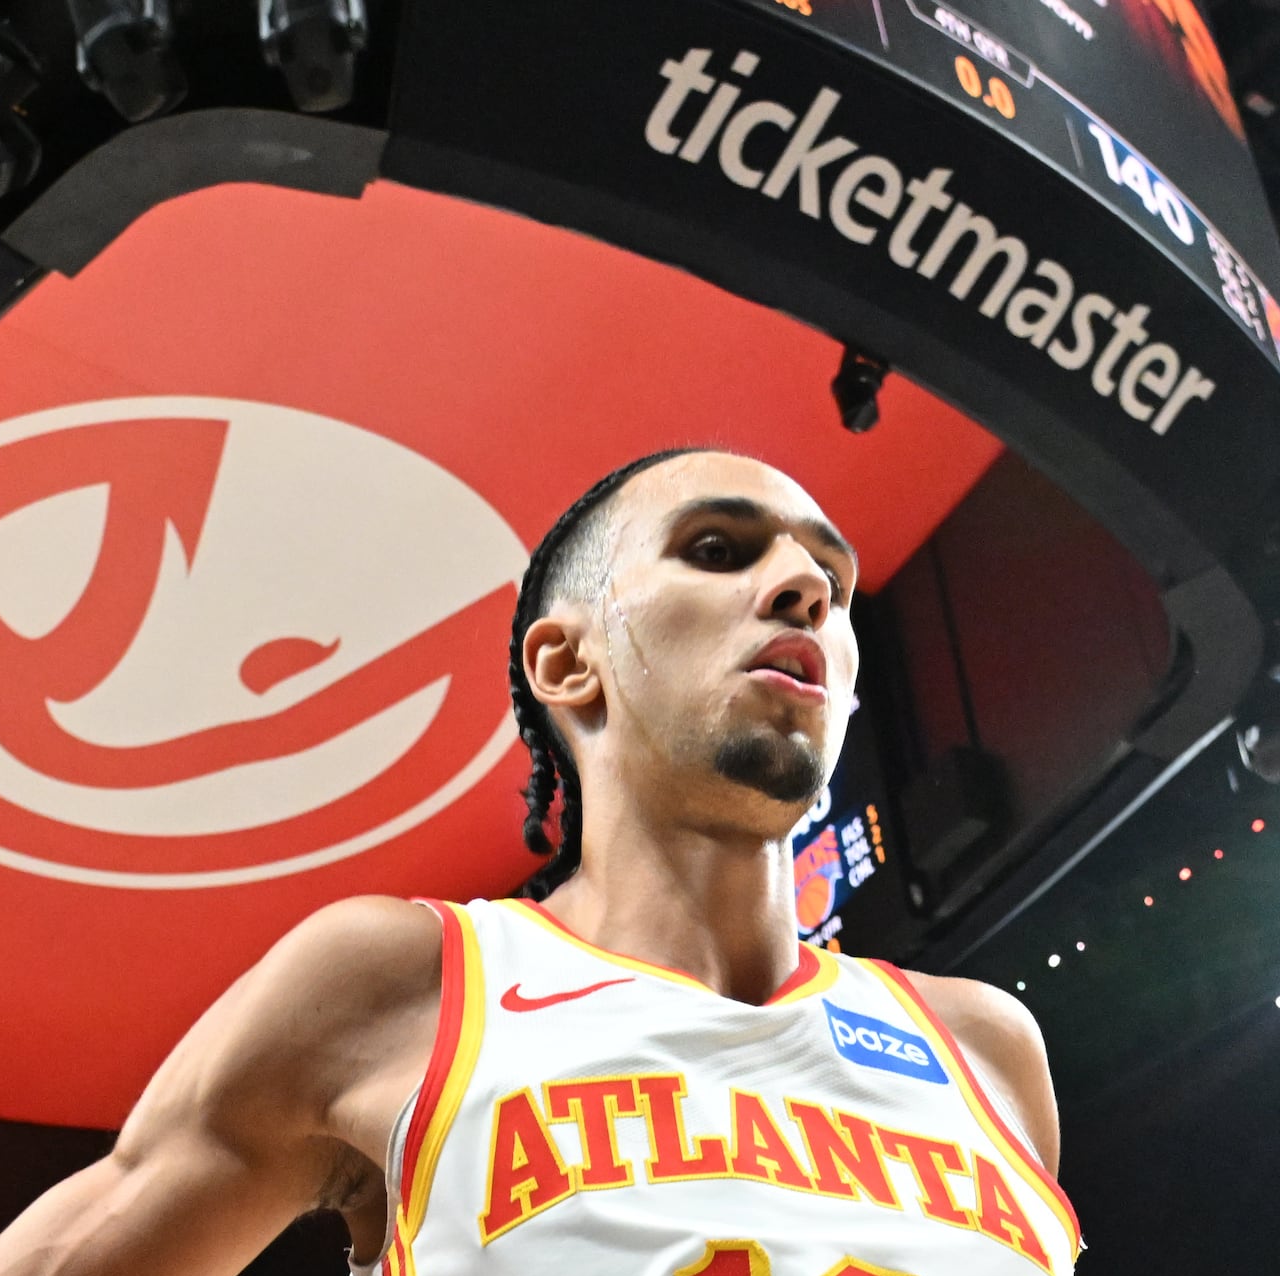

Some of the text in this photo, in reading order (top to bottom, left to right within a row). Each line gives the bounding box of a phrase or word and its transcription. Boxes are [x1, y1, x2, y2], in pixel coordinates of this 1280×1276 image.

[954, 55, 1017, 120] 0.0
[1088, 122, 1196, 246] 140
[643, 46, 1215, 437] ticketmaster
[830, 1015, 931, 1066] paze
